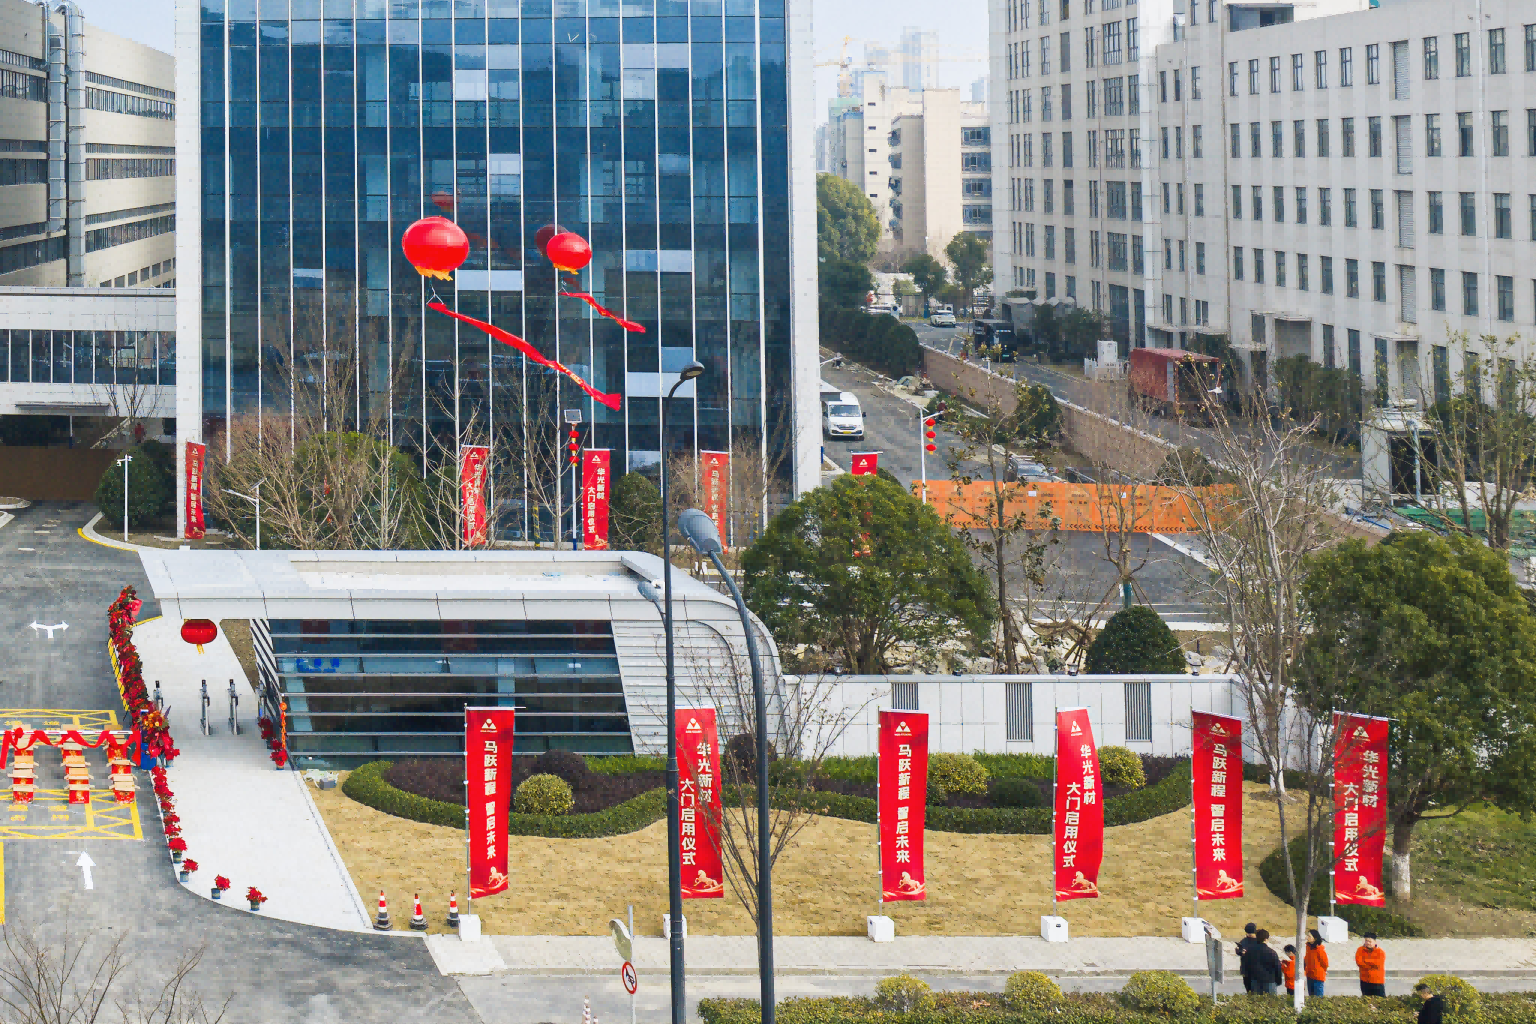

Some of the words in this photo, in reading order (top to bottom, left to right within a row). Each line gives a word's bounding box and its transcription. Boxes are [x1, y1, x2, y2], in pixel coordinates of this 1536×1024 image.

[484, 740, 498, 796] 马跃新程
[897, 744, 912, 801] 马跃新程
[1080, 744, 1096, 805] 华光新材
[1210, 743, 1228, 798] 马跃新程
[680, 778, 697, 866] 大门启用仪式
[895, 806, 911, 864] 智启未来
[1062, 781, 1082, 868] 大门启用仪式
[1210, 803, 1226, 862] 智启未来
[1343, 782, 1360, 872] 大门启用仪式
